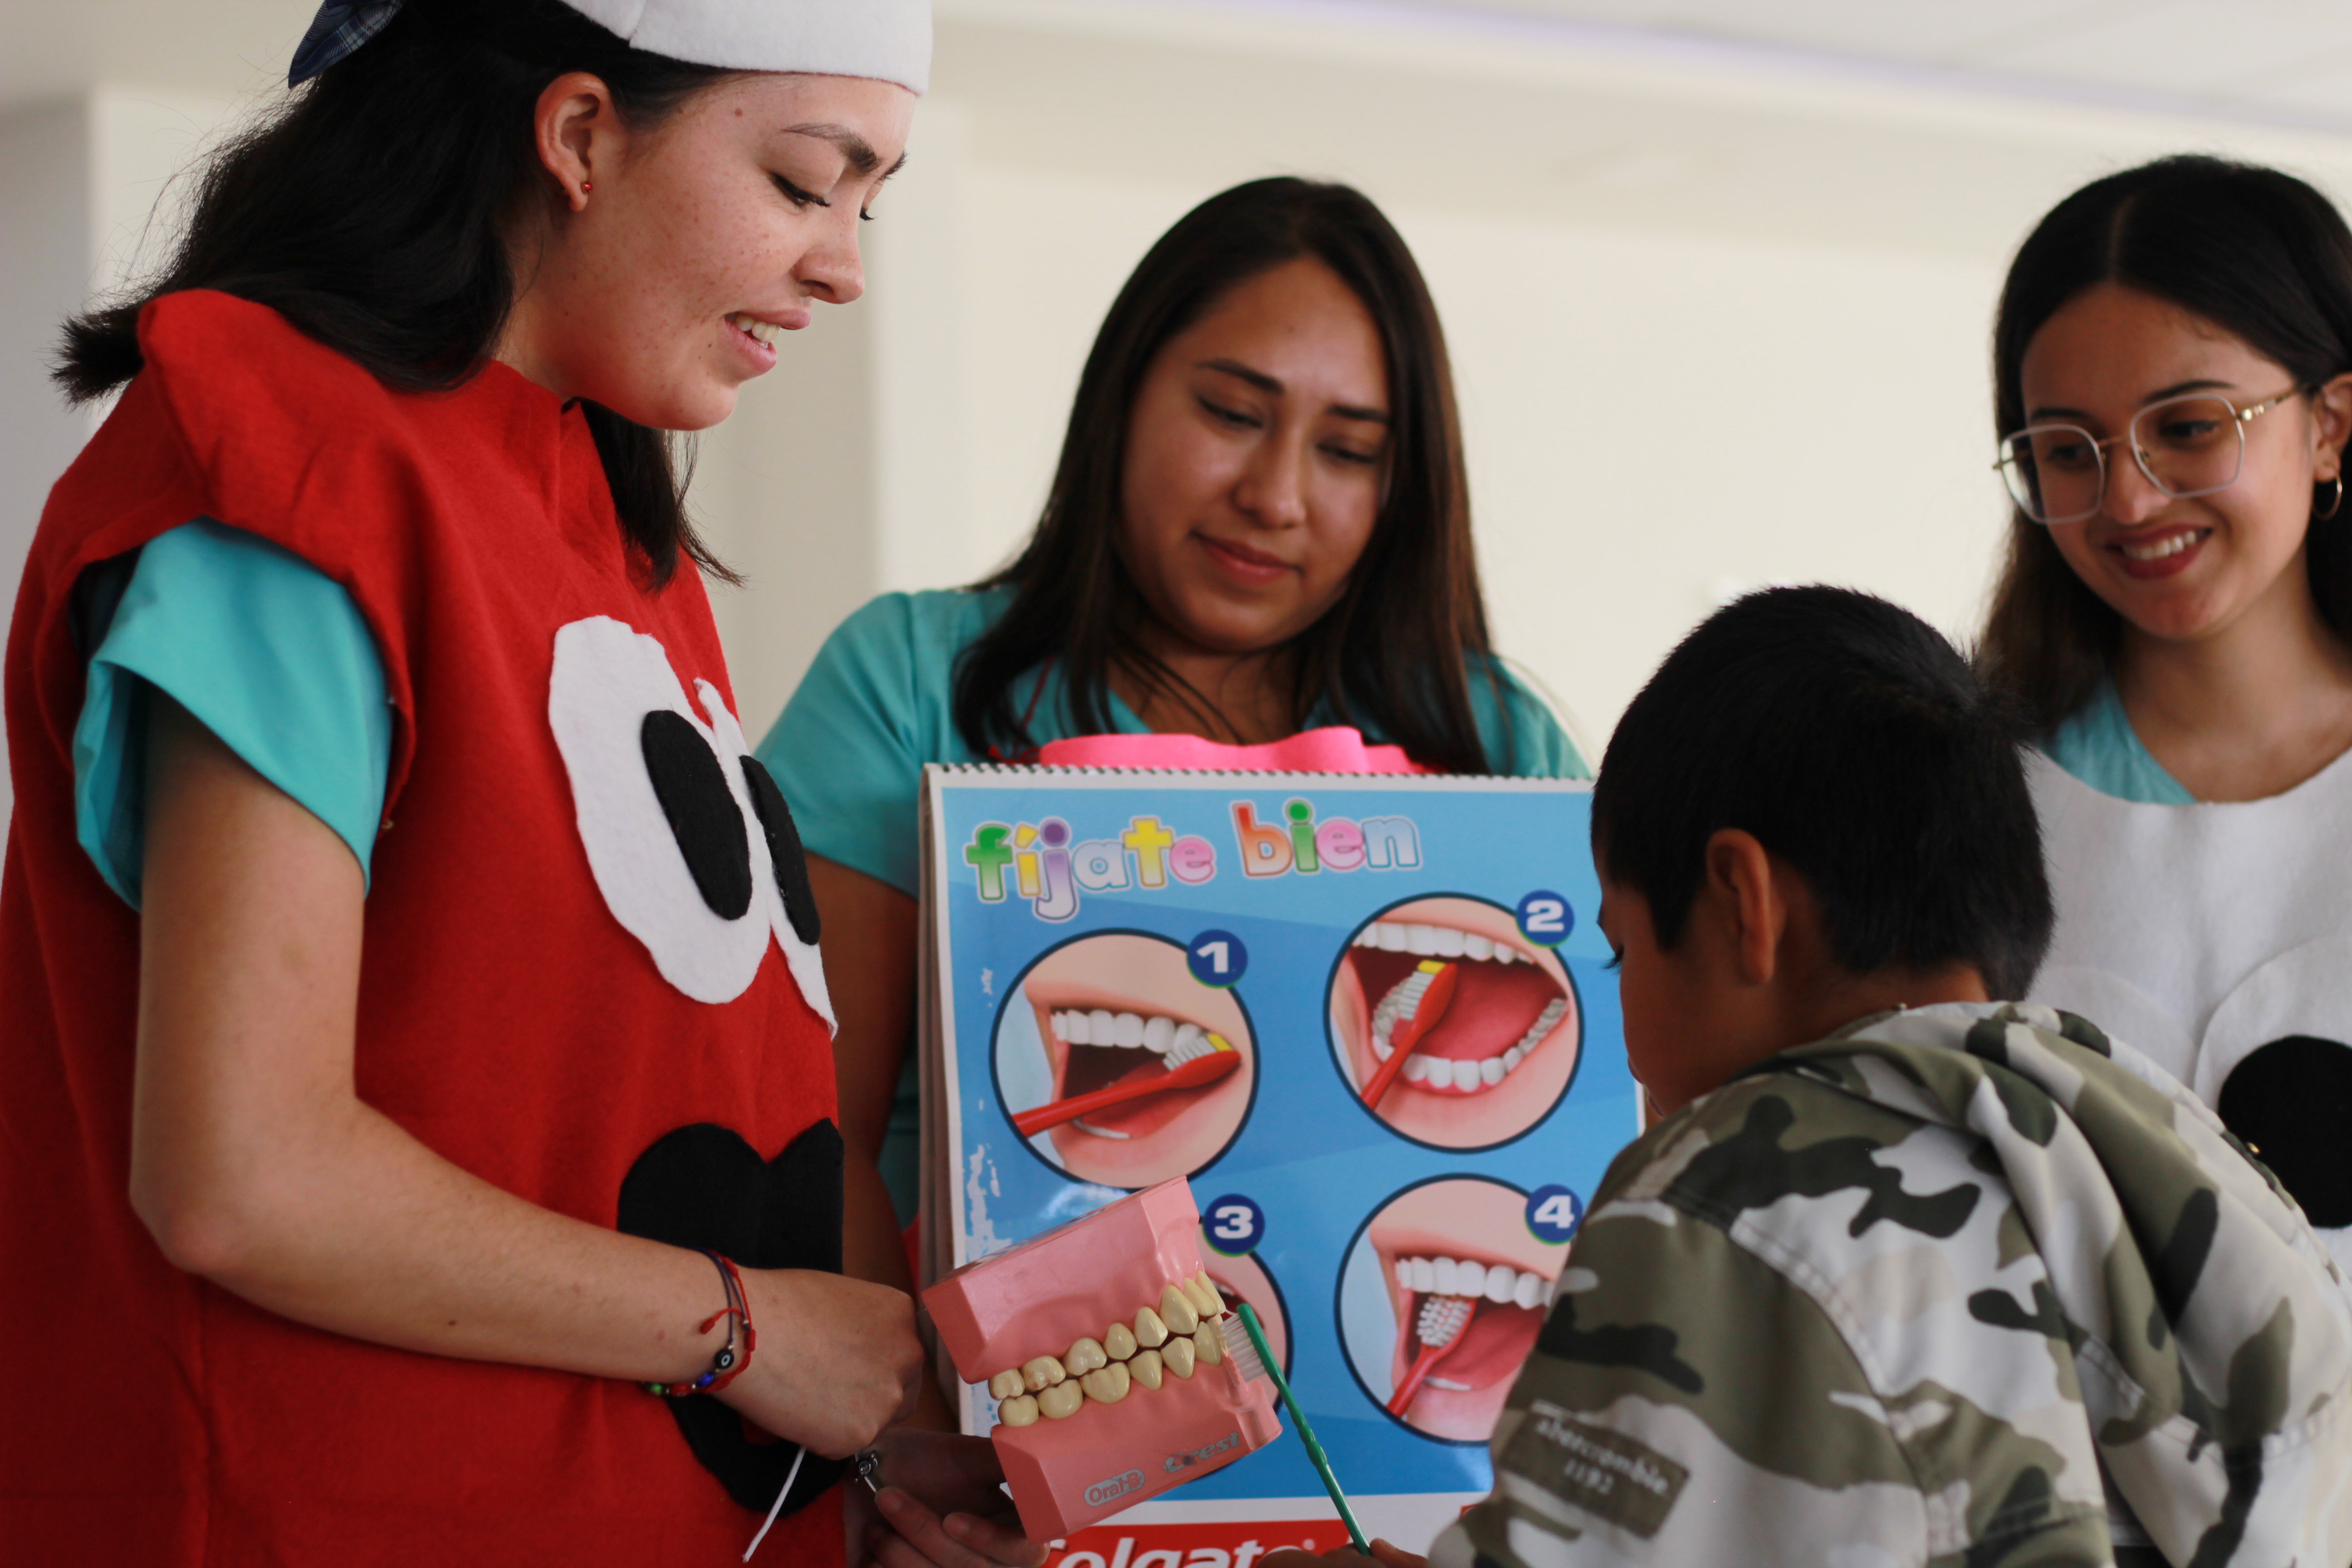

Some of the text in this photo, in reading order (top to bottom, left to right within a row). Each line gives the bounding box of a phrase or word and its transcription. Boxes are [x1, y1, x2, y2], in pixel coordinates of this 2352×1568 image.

[964, 798, 1421, 922] fíjate bien
[1525, 900, 1564, 932] 2
[1196, 941, 1229, 973] 1
[1214, 1205, 1254, 1239] 3
[1534, 1195, 1575, 1228] 4
[1089, 1471, 1141, 1503] Oral-B
